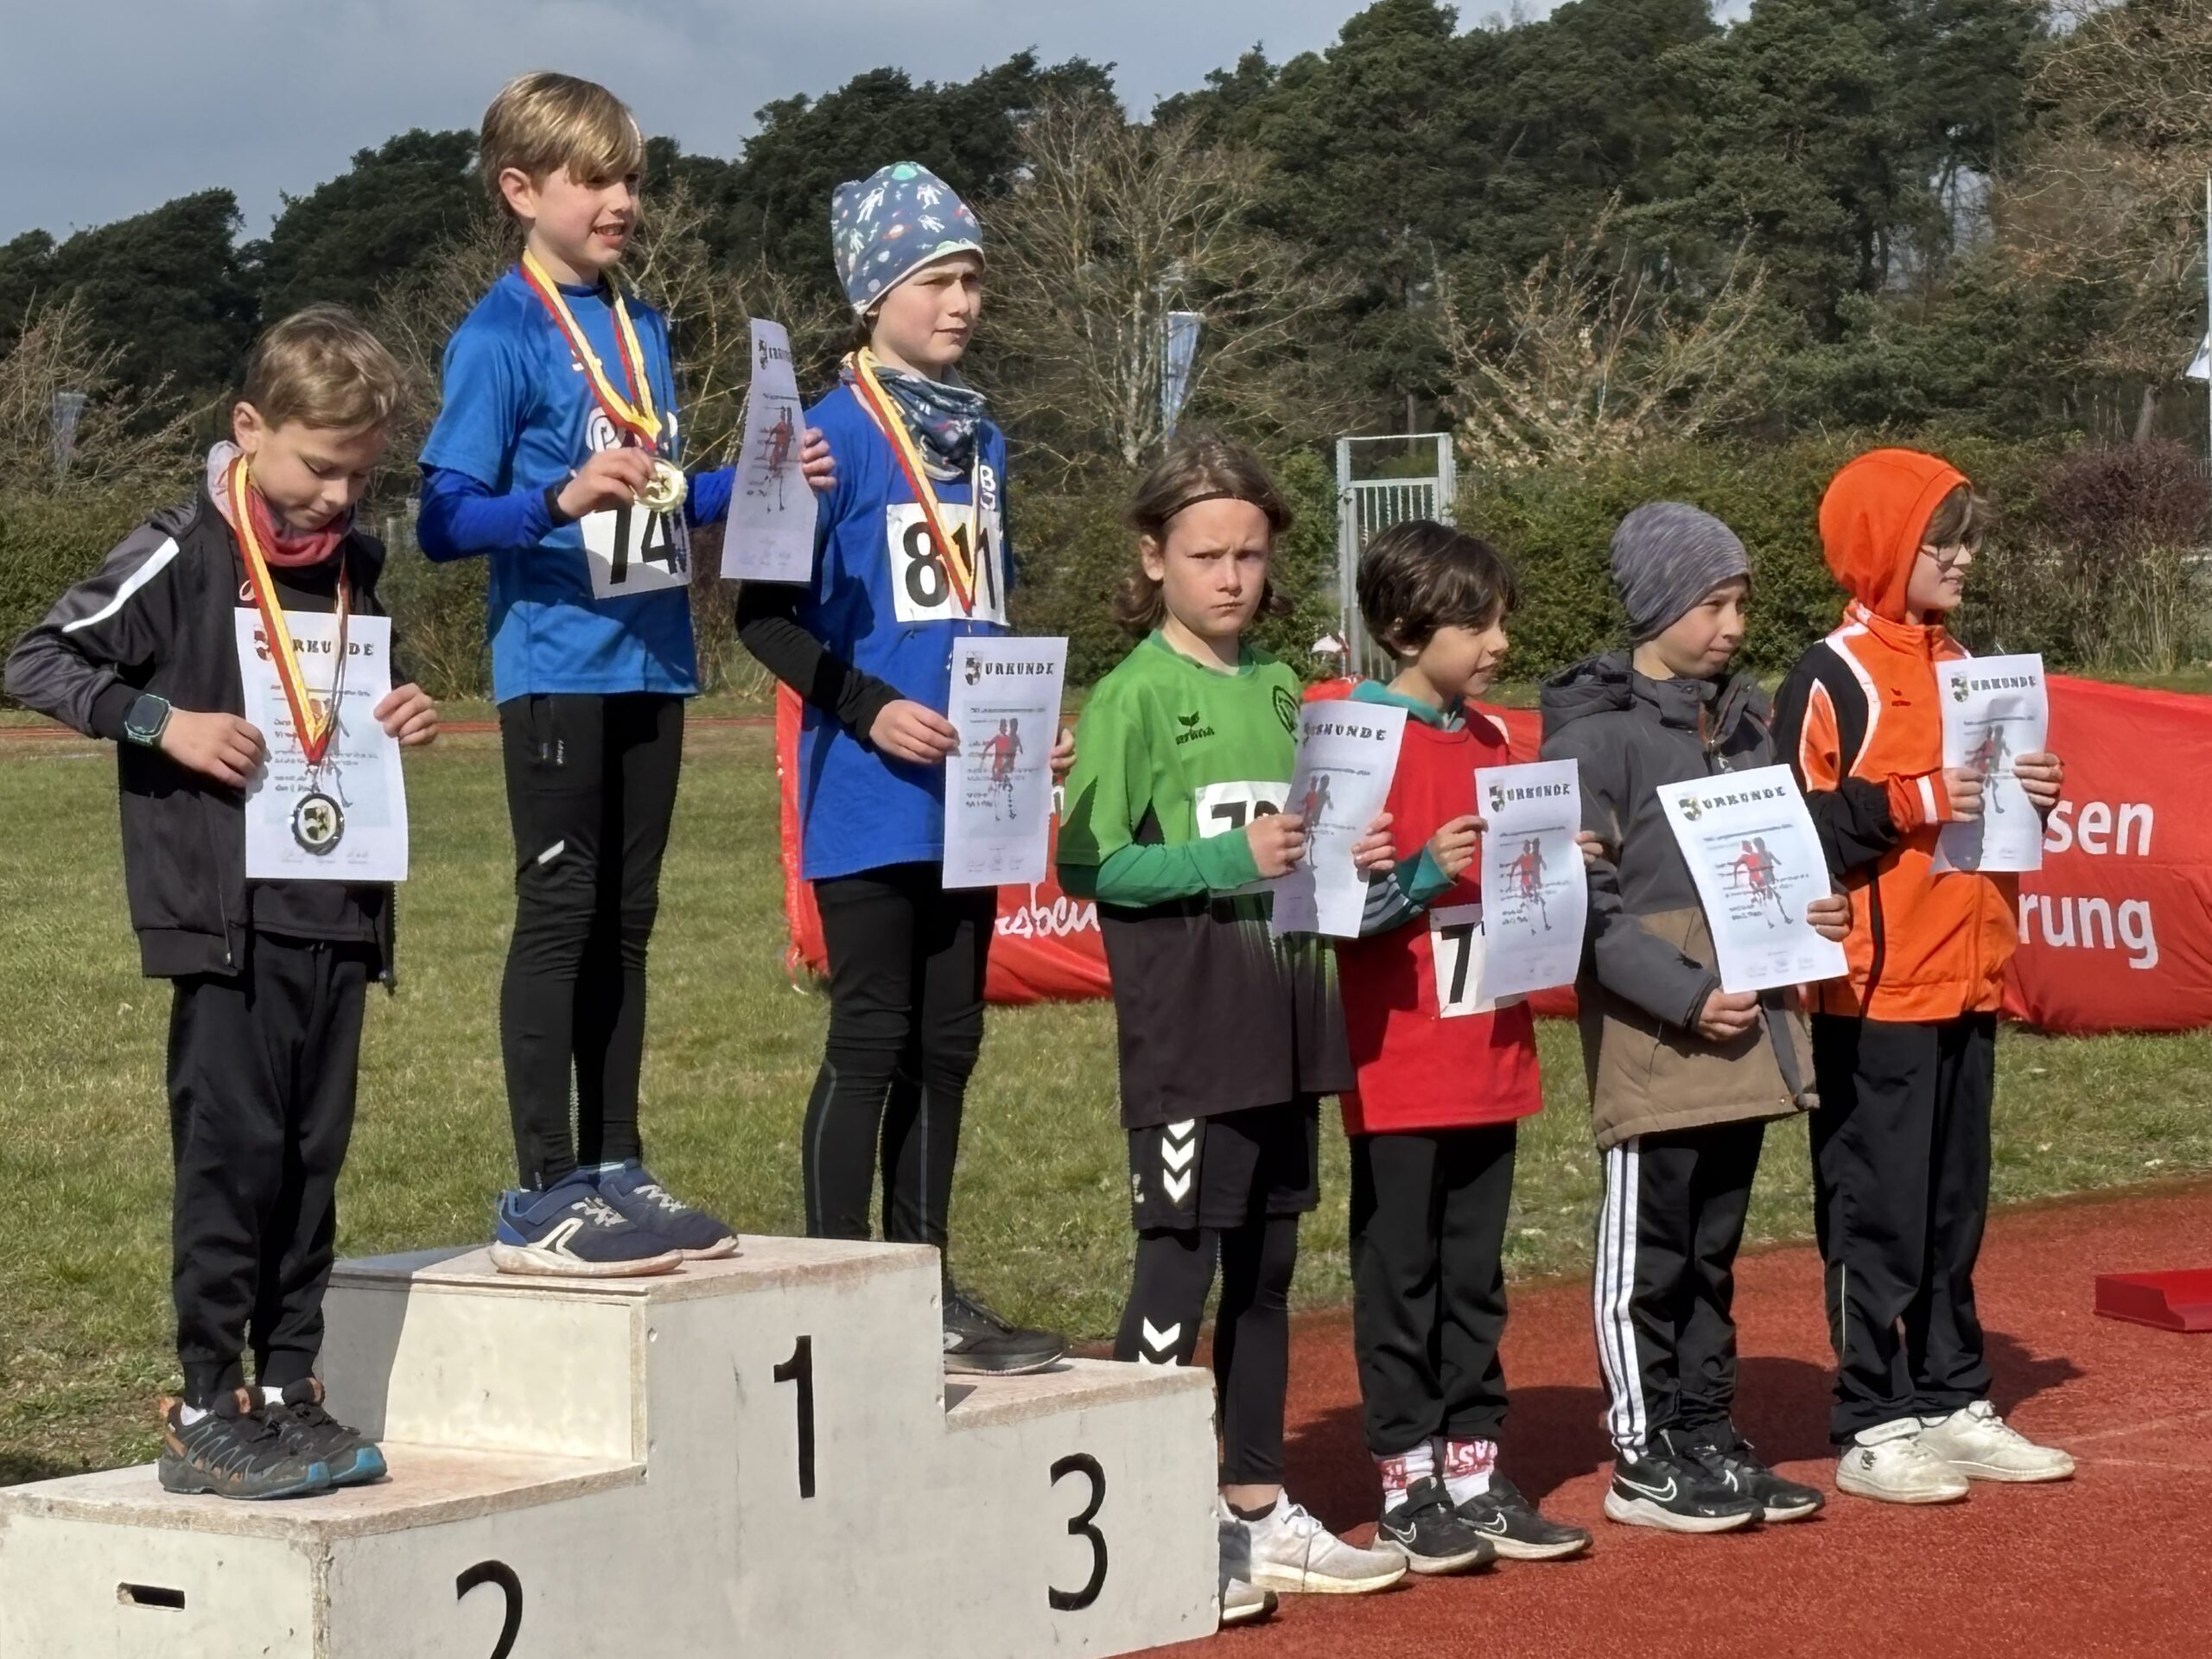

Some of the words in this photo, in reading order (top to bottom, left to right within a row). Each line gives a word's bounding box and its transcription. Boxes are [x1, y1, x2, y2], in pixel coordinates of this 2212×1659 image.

[903, 521, 996, 610] 811
[985, 662, 1055, 676] URKUNDE
[1970, 675, 2037, 691] URKUNDE
[1506, 783, 1571, 801] URKUNDE
[1701, 785, 1787, 810] URKUNDE
[2043, 799, 2154, 856] sen
[1440, 920, 1485, 1004] 7
[2018, 893, 2159, 969] rung
[773, 1334, 815, 1498] 1
[1048, 1452, 1109, 1612] 3
[456, 1559, 524, 1659] 2
